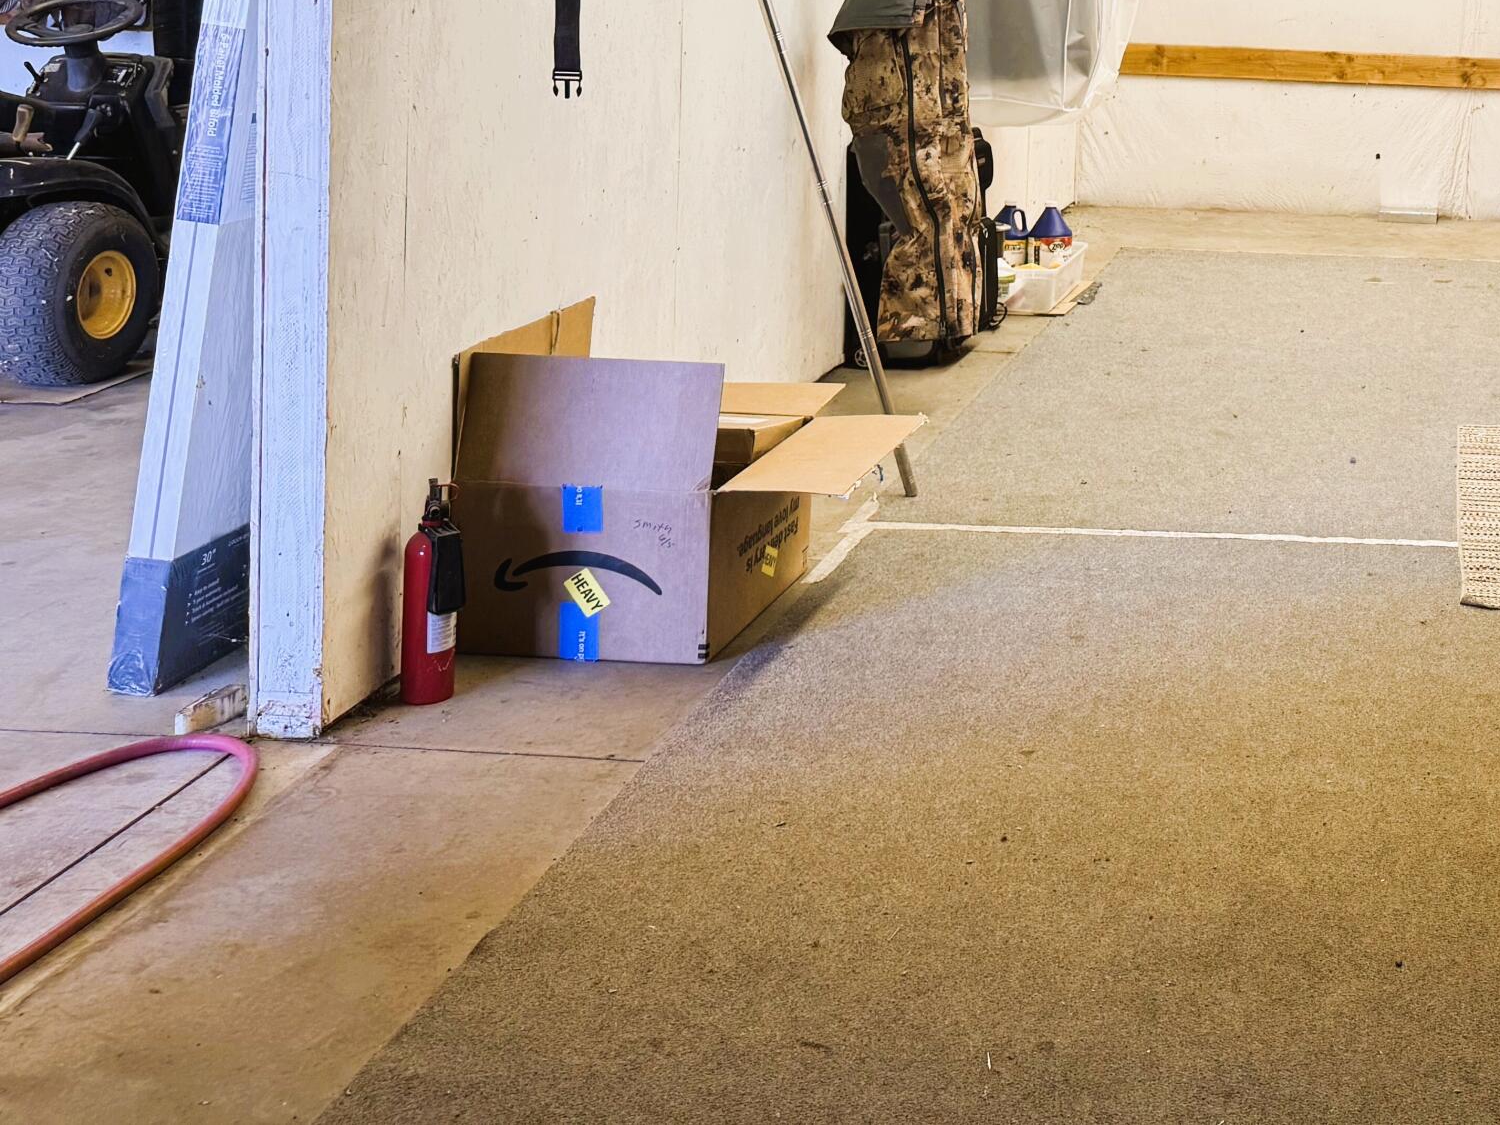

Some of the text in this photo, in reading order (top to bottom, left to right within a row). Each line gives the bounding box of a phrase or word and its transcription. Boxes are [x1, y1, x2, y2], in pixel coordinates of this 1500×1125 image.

[211, 68, 225, 107] Molded
[774, 505, 789, 528] love
[789, 495, 800, 513] my
[571, 573, 604, 611] HEAVY
